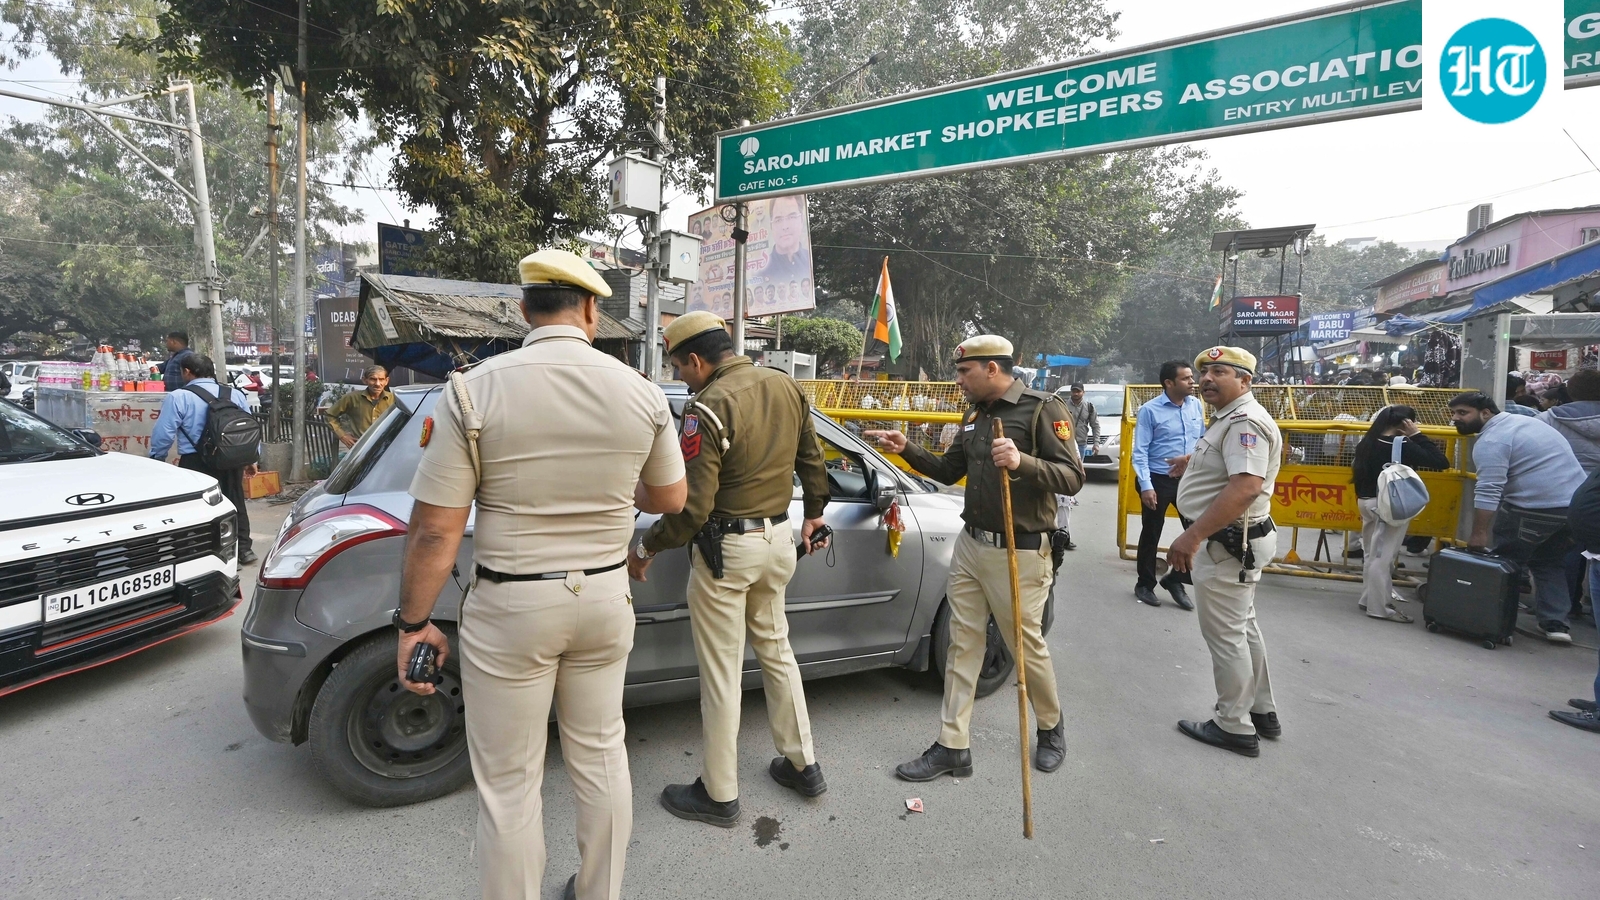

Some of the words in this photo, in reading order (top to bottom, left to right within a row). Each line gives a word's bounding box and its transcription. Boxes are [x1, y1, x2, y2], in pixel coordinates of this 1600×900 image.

[986, 62, 1157, 111] WELCOME
[1223, 98, 1297, 121] ENTRY
[1302, 87, 1367, 109] MULTI
[1372, 79, 1422, 99] LEV
[743, 147, 830, 175] SAROJINI
[836, 130, 932, 160] MARKET
[941, 90, 1163, 143] SHOPKEEPERS
[1178, 44, 1422, 105] ASSOCIATIO
[738, 180, 765, 192] GATE
[385, 241, 409, 251] GATE
[316, 259, 336, 273] safari
[1412, 269, 1443, 287] GALLERY
[1253, 301, 1263, 310] P.
[1266, 300, 1277, 310] S.
[1318, 320, 1345, 329] BABU
[1311, 329, 1351, 338] MARKET
[1273, 474, 1347, 507] पुलिस
[1296, 510, 1317, 520] थाना
[22, 518, 176, 551] EXTER
[60, 569, 171, 613] DL1CAG8588
